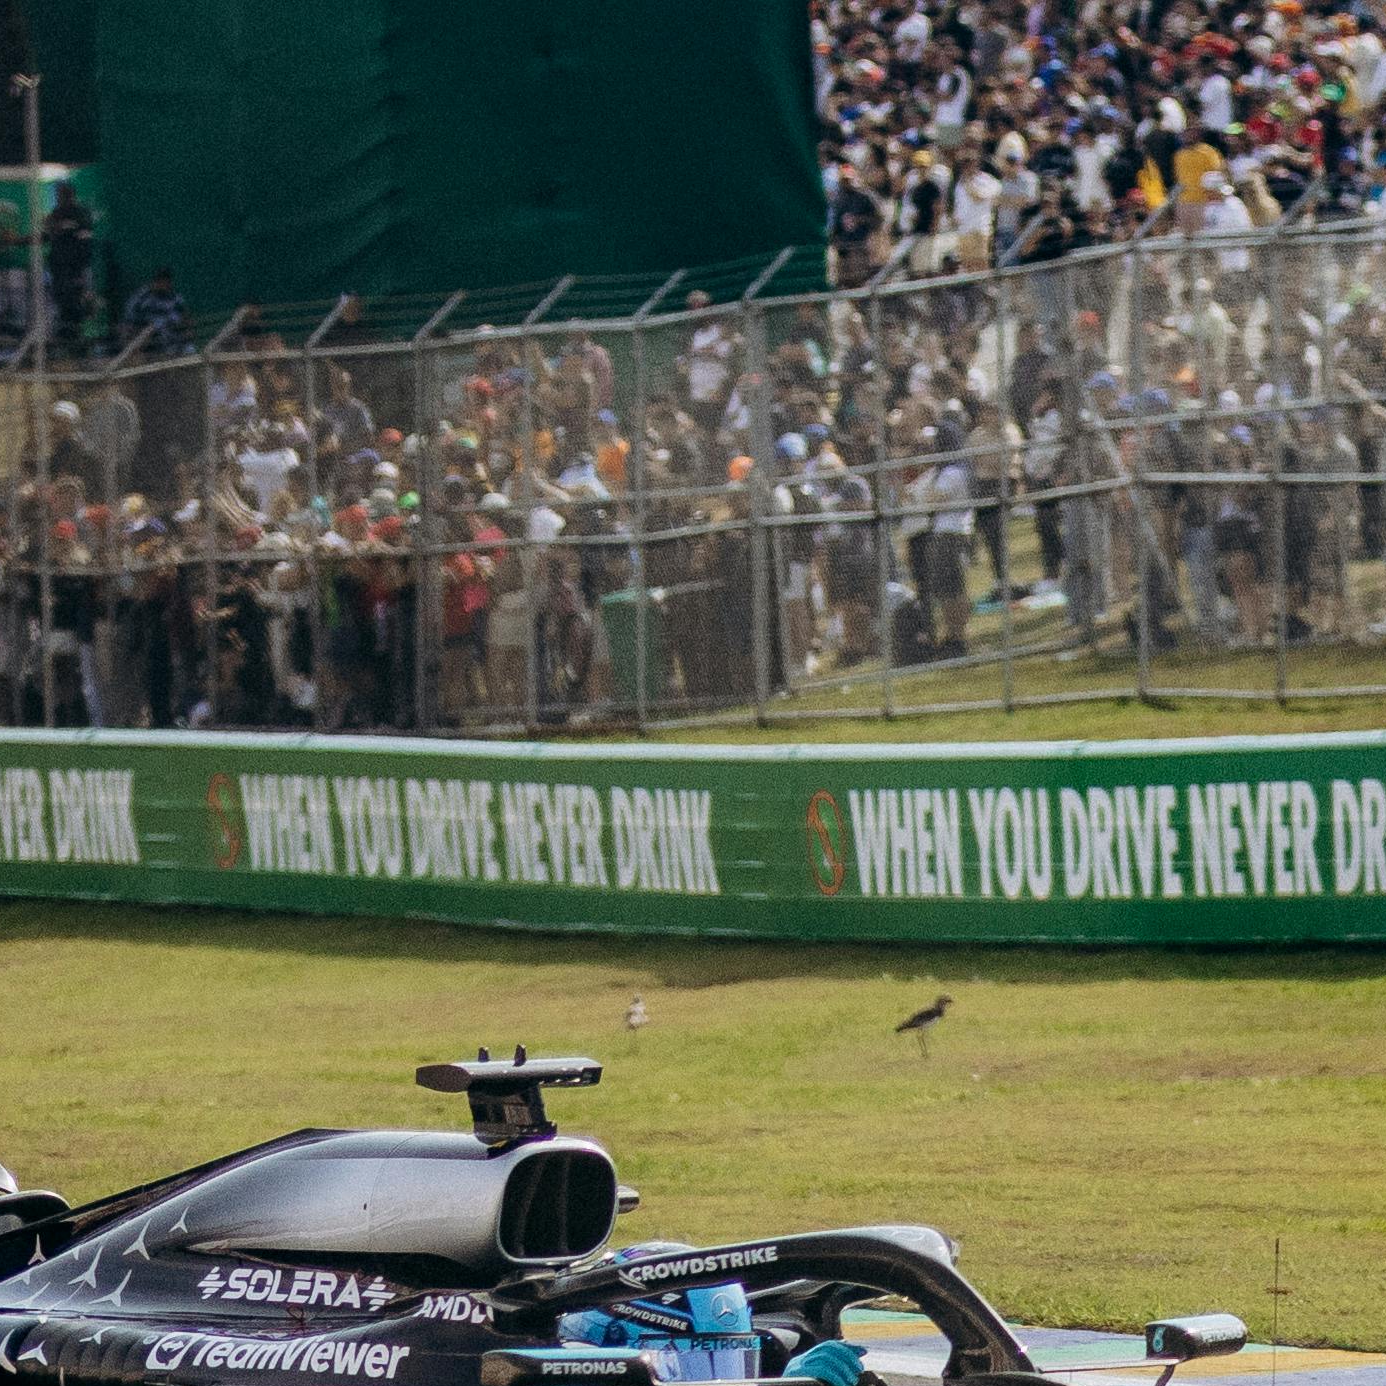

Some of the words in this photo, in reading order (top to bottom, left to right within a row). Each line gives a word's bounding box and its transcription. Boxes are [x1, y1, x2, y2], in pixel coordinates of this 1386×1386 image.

[49, 769, 140, 864] DRINK
[239, 774, 336, 873] WHEN
[332, 776, 404, 879] YOU
[405, 778, 501, 882] DRIVE
[501, 781, 608, 887] NEVER
[611, 786, 720, 894] DRINK
[849, 787, 963, 897] WHEN
[967, 786, 1052, 899] YOU
[1061, 784, 1183, 898] DRIVE
[1188, 781, 1322, 897] NEVER
[628, 1246, 778, 1282] CROWDSTRIKE
[223, 1268, 362, 1309] SOLERA
[420, 1295, 472, 1321] AMD
[612, 1303, 689, 1331] CROWDSTRIKE
[192, 1335, 410, 1379] TeamViewer
[541, 1361, 628, 1375] PETRONAS
